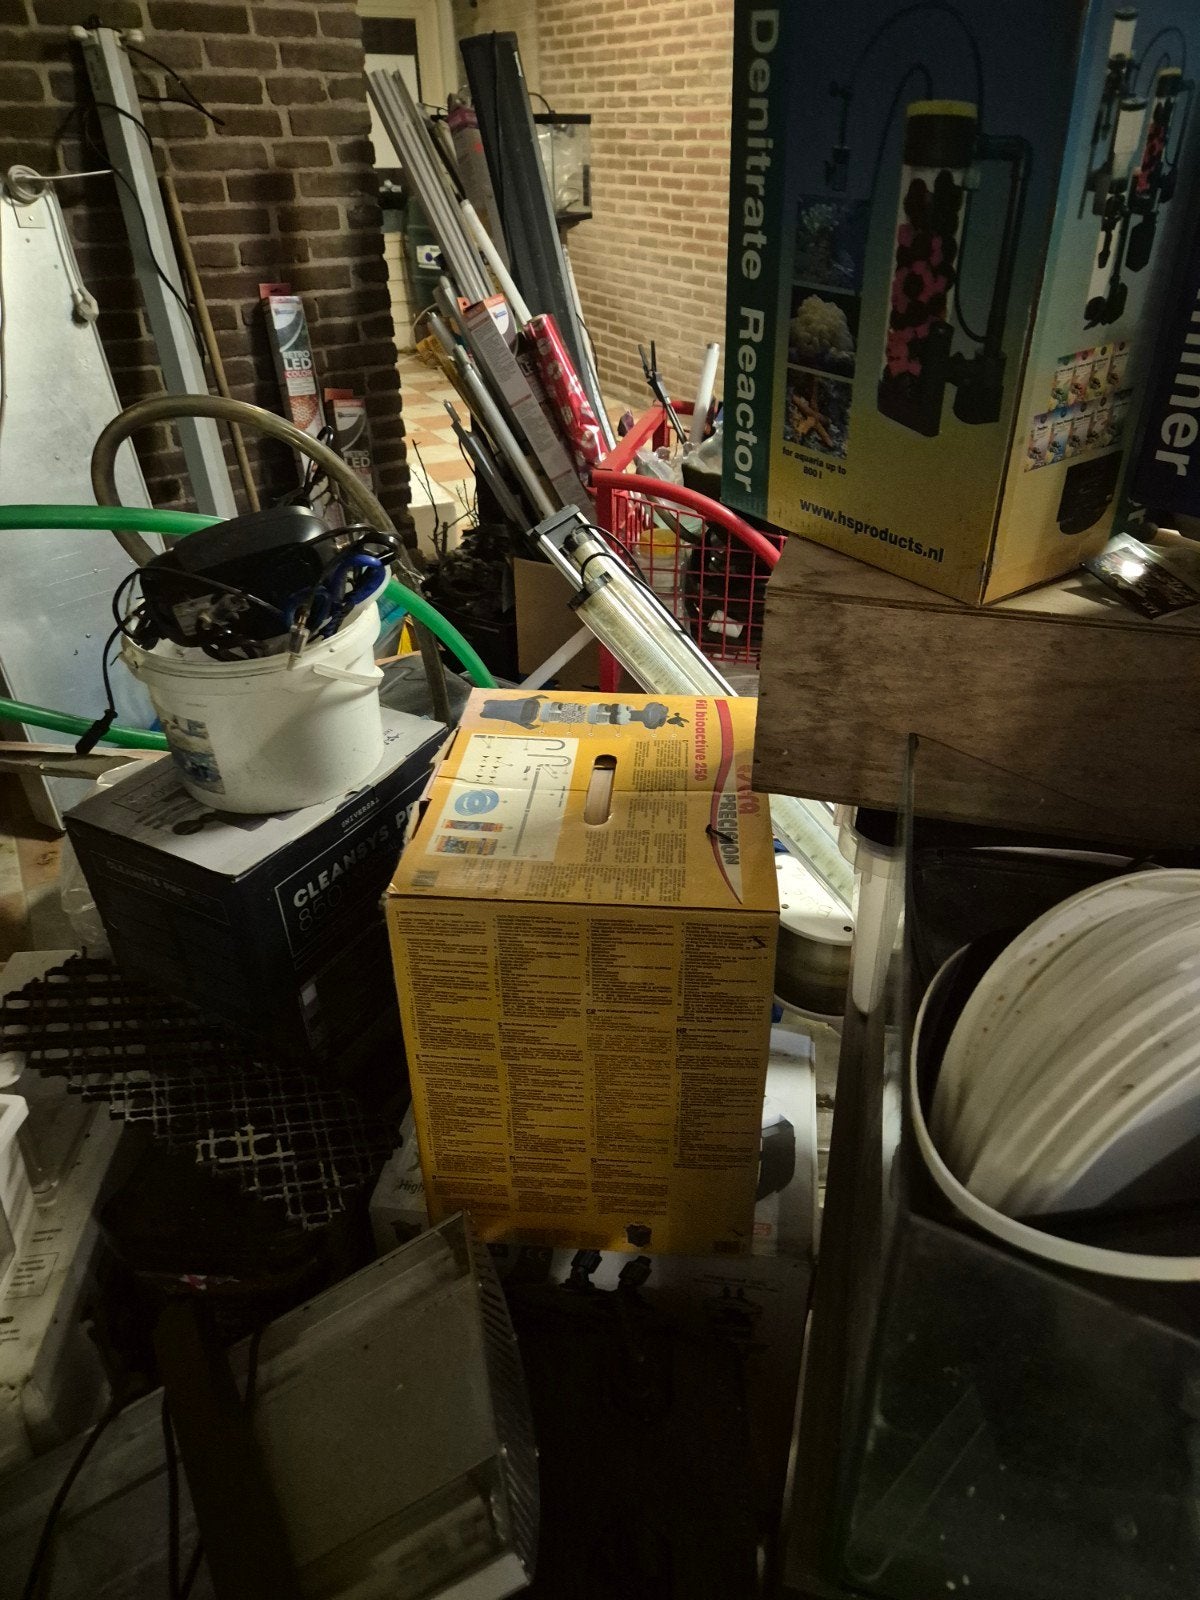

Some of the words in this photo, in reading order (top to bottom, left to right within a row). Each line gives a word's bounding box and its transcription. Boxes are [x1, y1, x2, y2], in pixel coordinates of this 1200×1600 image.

[741, 9, 780, 281] Denitrate
[283, 358, 312, 371] LED
[734, 306, 765, 493] Reactor
[344, 457, 371, 468] LED
[782, 446, 793, 457] for
[794, 452, 824, 468] aquaria
[825, 462, 836, 474] up
[838, 466, 847, 476] to
[799, 498, 945, 563] www.hsproducts.nl
[695, 712, 709, 760] bioactive
[694, 761, 708, 782] 250
[717, 794, 740, 866] PRECISION
[293, 824, 390, 908] CLEANSYS
